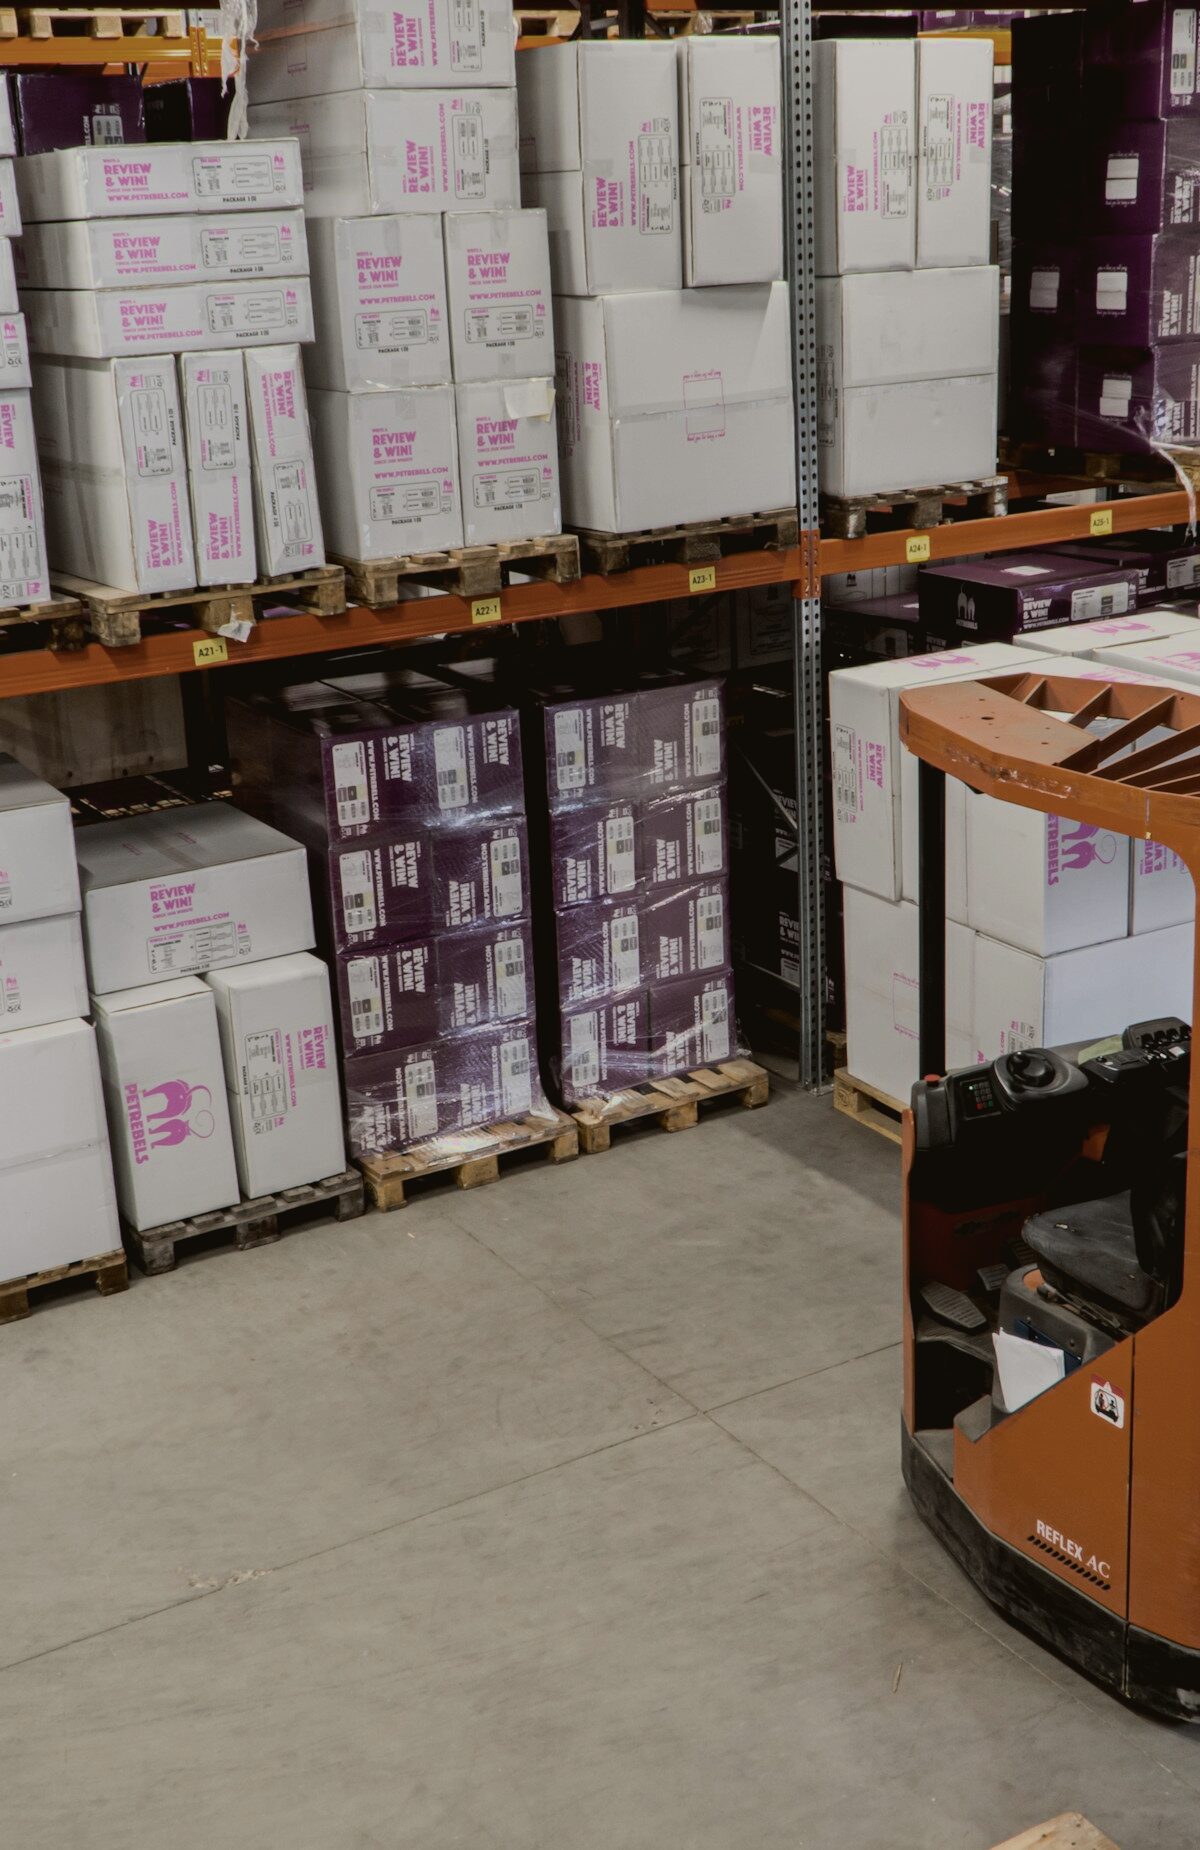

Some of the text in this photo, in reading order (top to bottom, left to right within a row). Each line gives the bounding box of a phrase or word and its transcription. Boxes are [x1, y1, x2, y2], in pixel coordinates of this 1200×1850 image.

[393, 12, 407, 66] REVIEW
[406, 18, 418, 65] & WIN!
[753, 107, 762, 150] & WIN!
[763, 107, 772, 156] REVIEW
[104, 163, 151, 175] REVIEW
[106, 176, 147, 186] & WIN!
[418, 146, 429, 192] & WIN!
[108, 192, 188, 202] WWW.PETREBELS.COM
[596, 176, 607, 227] REVIEW
[608, 183, 618, 226] & WIN!
[113, 236, 160, 248] REVIEW
[115, 250, 156, 260] & WIN!
[467, 253, 510, 266] REVIEW
[117, 264, 196, 274] WWW.PETREBELS.COM
[357, 256, 402, 270] REVIEW
[358, 270, 398, 283] & WIN!
[469, 267, 506, 279] & WIN!
[122, 304, 166, 315] REVIEW
[360, 294, 435, 305] WWW.PETREBELS.COM
[469, 290, 541, 300] WWW.PETREBELS.COM
[122, 316, 163, 327] & WIN!
[124, 330, 203, 341] WWW.PETREBELS.COM
[273, 373, 286, 416] & WIN!
[283, 371, 295, 419] REVIEW
[592, 363, 600, 410] REVIEW
[1, 404, 14, 449] REVIEW
[372, 431, 416, 446] REVIEW
[476, 420, 518, 434] REVIEW
[477, 433, 514, 447] & WIN!
[374, 445, 412, 458] & WIN!
[478, 454, 548, 467] WWW.PETREBELS.COM
[159, 522, 170, 555] WIN!
[209, 512, 220, 560] REVIEW
[219, 517, 230, 559] & WIN!
[1092, 518, 1109, 528] A25-1
[148, 520, 161, 568] REVIEW
[692, 574, 712, 584] A23-1
[475, 605, 497, 616] A22-1
[1023, 598, 1052, 610] REVIEW
[1023, 608, 1048, 619] & WIN!
[198, 645, 223, 657] A21-1
[486, 721, 498, 762] & WIN!
[497, 719, 509, 765] REVIEW
[605, 705, 615, 746] & WIN!
[615, 704, 625, 748] REVIEW
[388, 736, 401, 779] & WIN!
[399, 734, 412, 782] REVIEW
[654, 739, 664, 783] REVIEW
[664, 742, 673, 770] WIN!
[394, 844, 407, 886] & WIN!
[405, 842, 419, 888] REVIEW
[656, 838, 667, 882] REVIEW
[666, 841, 676, 869] WIN!
[1048, 813, 1058, 885] ETREBELS
[150, 883, 195, 901] REVIEW
[567, 858, 577, 901] REVIEW
[577, 861, 586, 889] WIN!
[152, 896, 192, 913] & WIN!
[449, 881, 461, 925] REVIEW
[460, 883, 471, 912] WIN!
[154, 912, 229, 932] WWW.PETREBELS.COM
[413, 948, 426, 992] REVIEW
[660, 936, 670, 978] REVIEW
[670, 938, 678, 966] WIN!
[402, 951, 414, 991] & WIN!
[454, 982, 466, 1026] REVIEW
[465, 984, 476, 1014] WIN!
[617, 1015, 627, 1043] WIN!
[626, 1002, 636, 1044] REVIEW
[303, 1029, 315, 1068] & WIN!
[313, 1026, 326, 1069] REVIEW
[285, 1034, 297, 1106] WWW.PETREBELS.COM
[124, 1083, 149, 1164] PETREBELS
[1036, 1519, 1110, 1578] REFLEX AC
